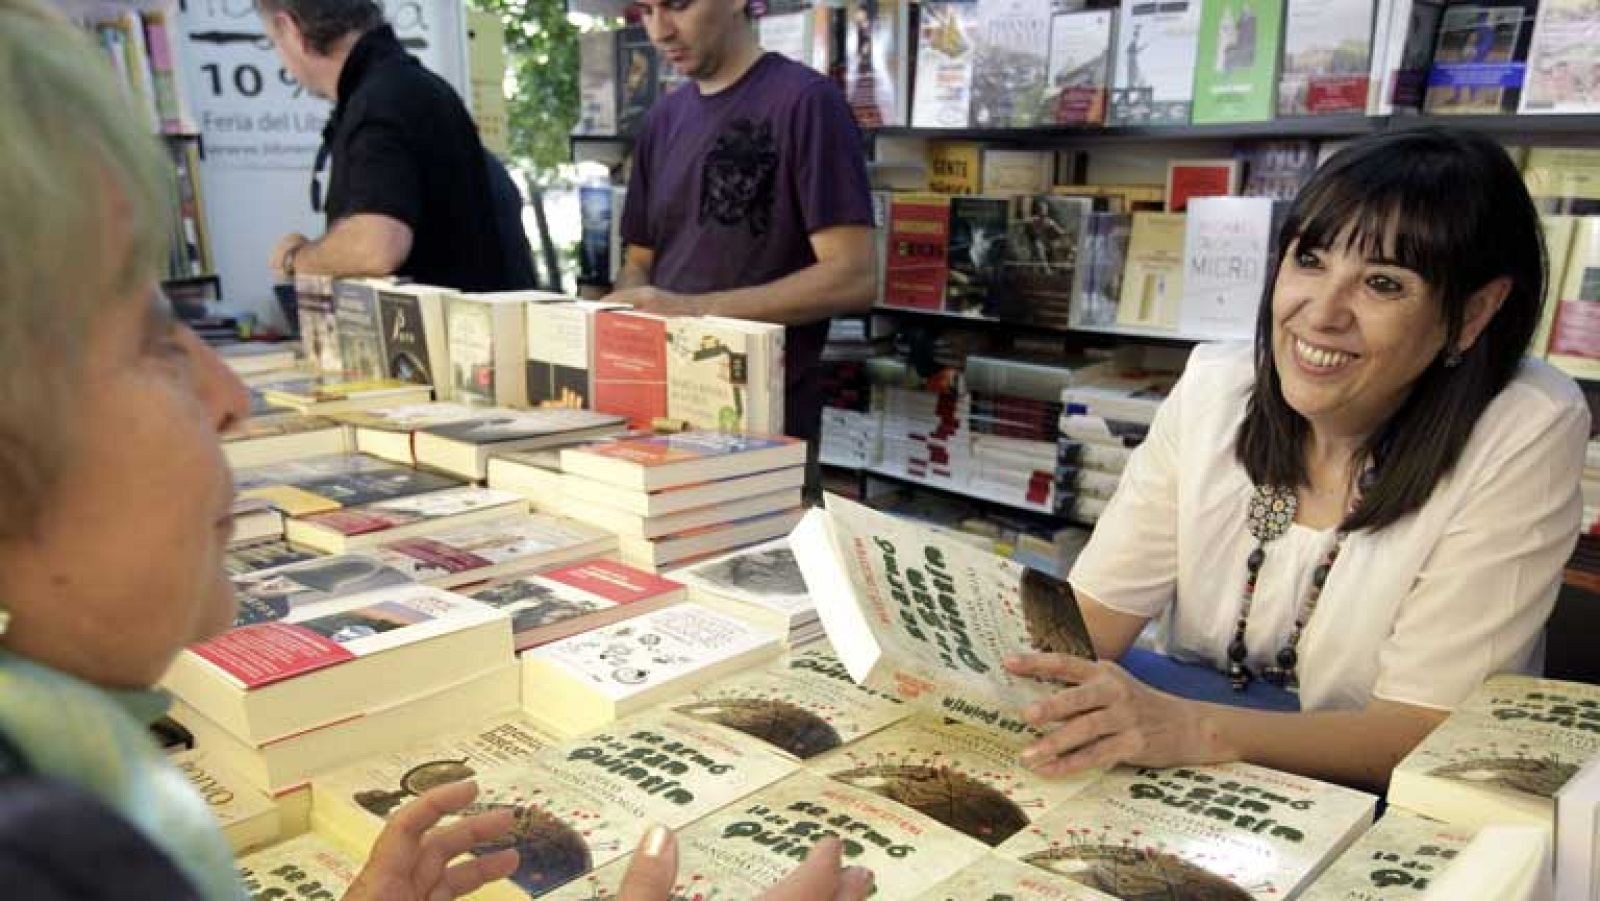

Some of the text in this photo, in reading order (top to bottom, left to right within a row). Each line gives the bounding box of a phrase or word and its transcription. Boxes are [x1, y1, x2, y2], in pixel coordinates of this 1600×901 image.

[201, 63, 263, 97] 10
[203, 111, 254, 133] Feria
[258, 110, 289, 133] del
[1491, 708, 1600, 735] Quin
[1549, 704, 1600, 720] Sa
[721, 821, 811, 863] Quin
